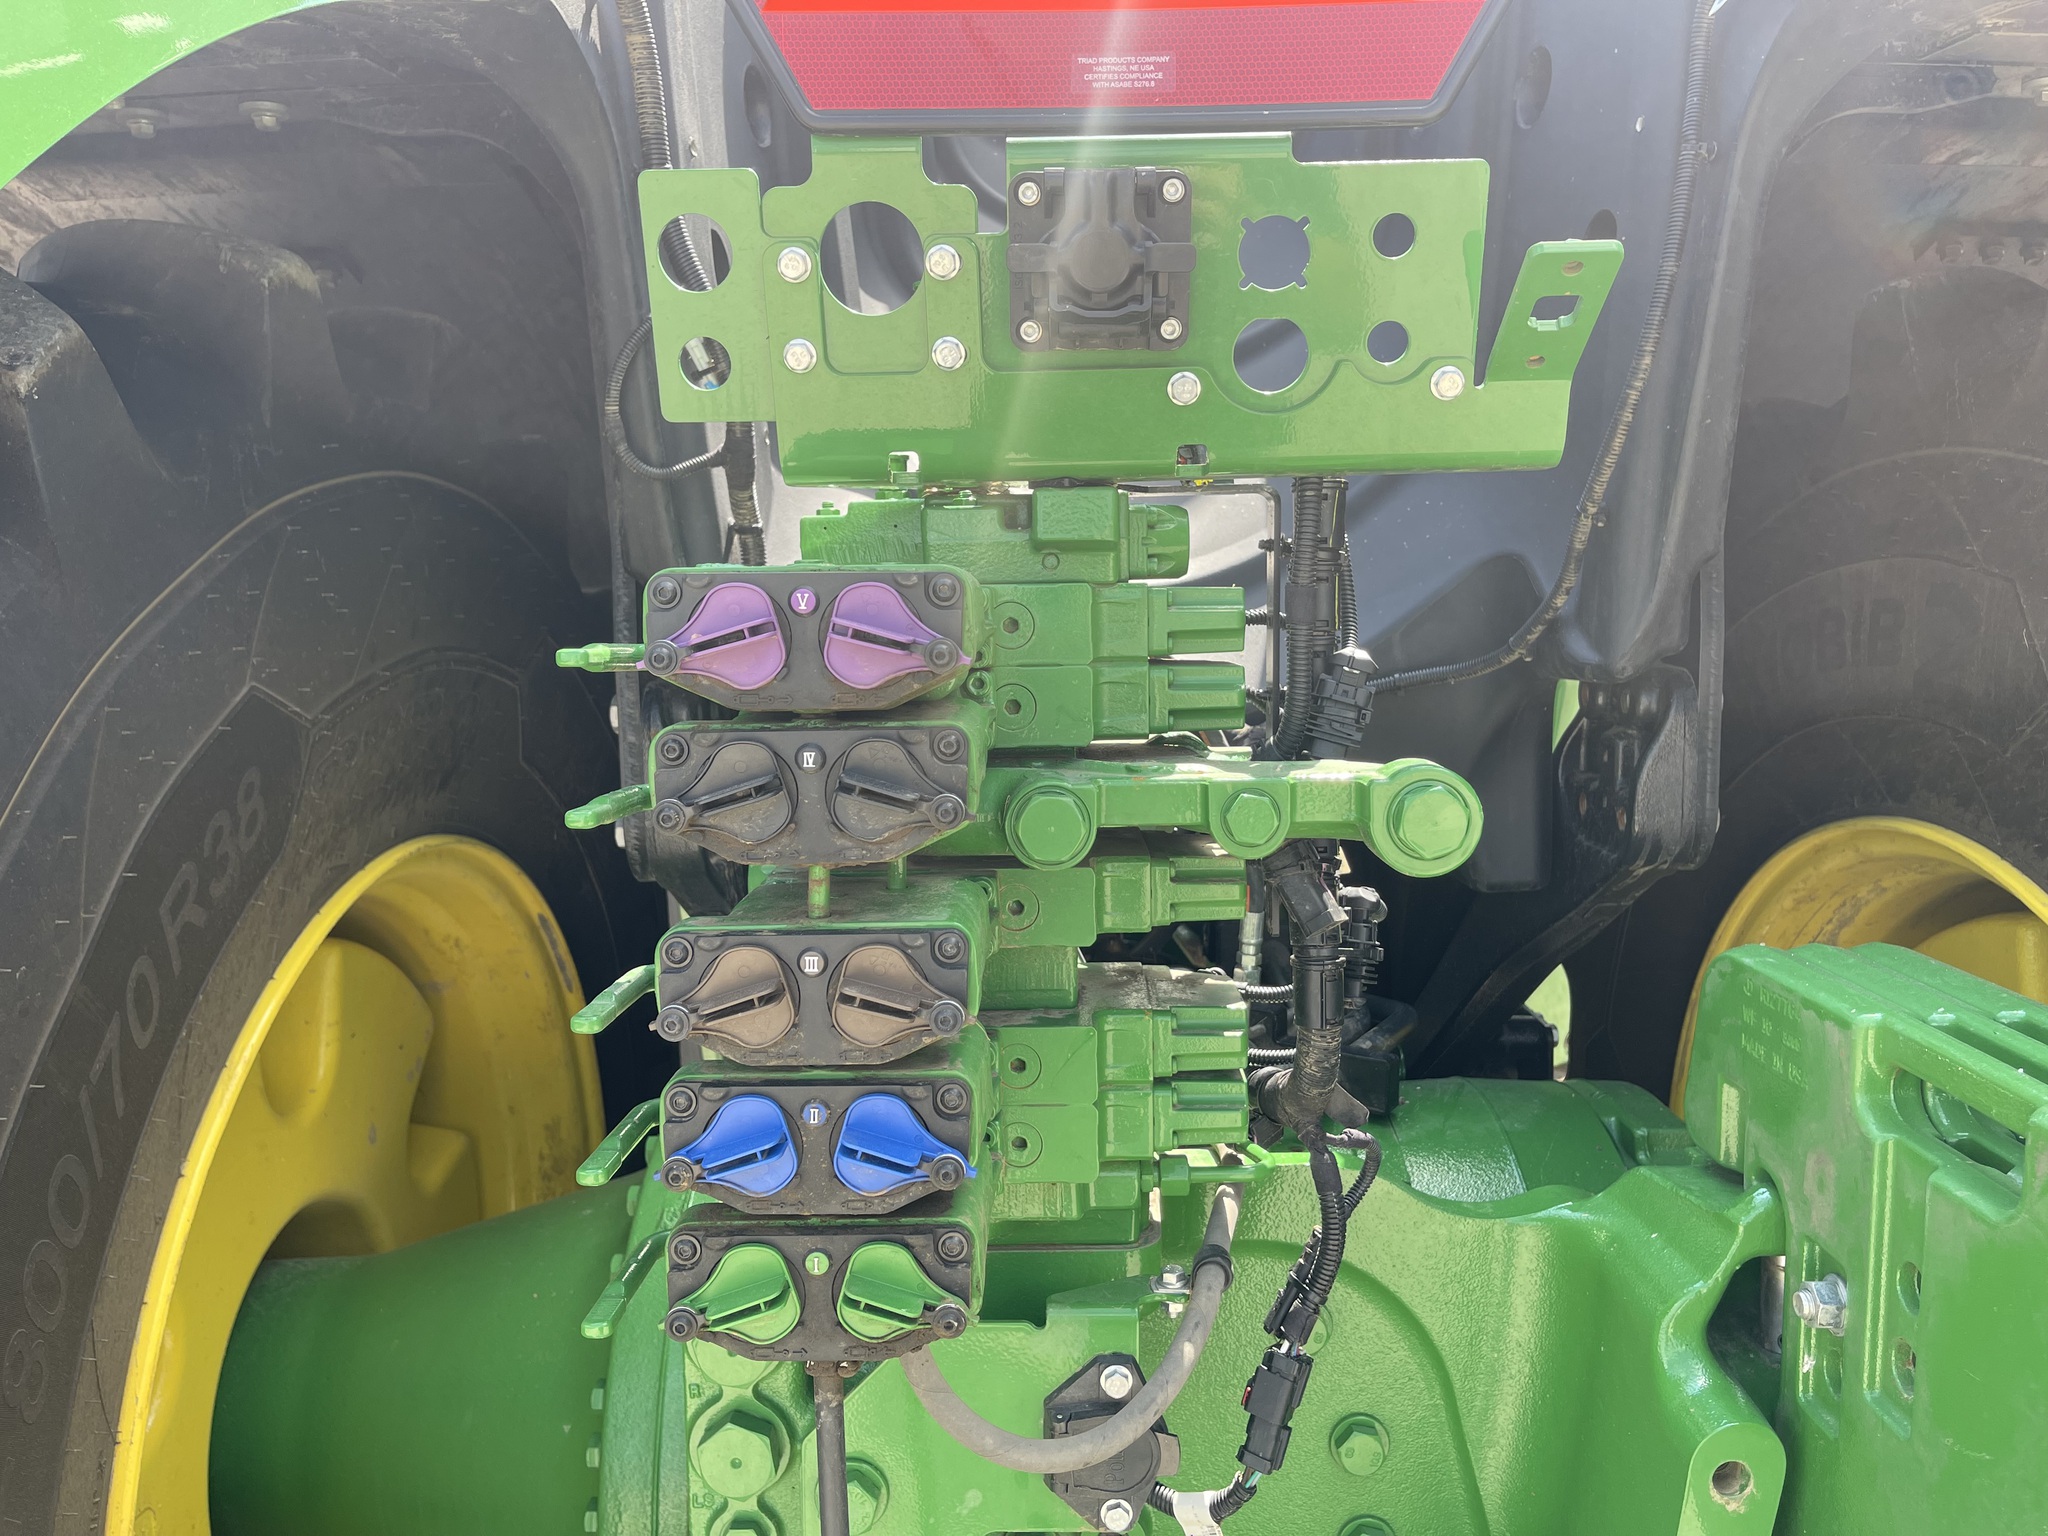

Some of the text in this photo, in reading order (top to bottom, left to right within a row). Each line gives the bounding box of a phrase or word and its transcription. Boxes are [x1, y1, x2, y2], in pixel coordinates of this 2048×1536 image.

[1077, 55, 1170, 65] TRIAD PRODUCTS COMPANY
[1129, 64, 1139, 72] NE
[1119, 72, 1164, 80] COMPLIANCE
[796, 593, 810, 610] V
[802, 751, 816, 768] IV
[804, 956, 819, 973] III
[809, 1108, 820, 1124] II
[813, 1257, 820, 1273] I
